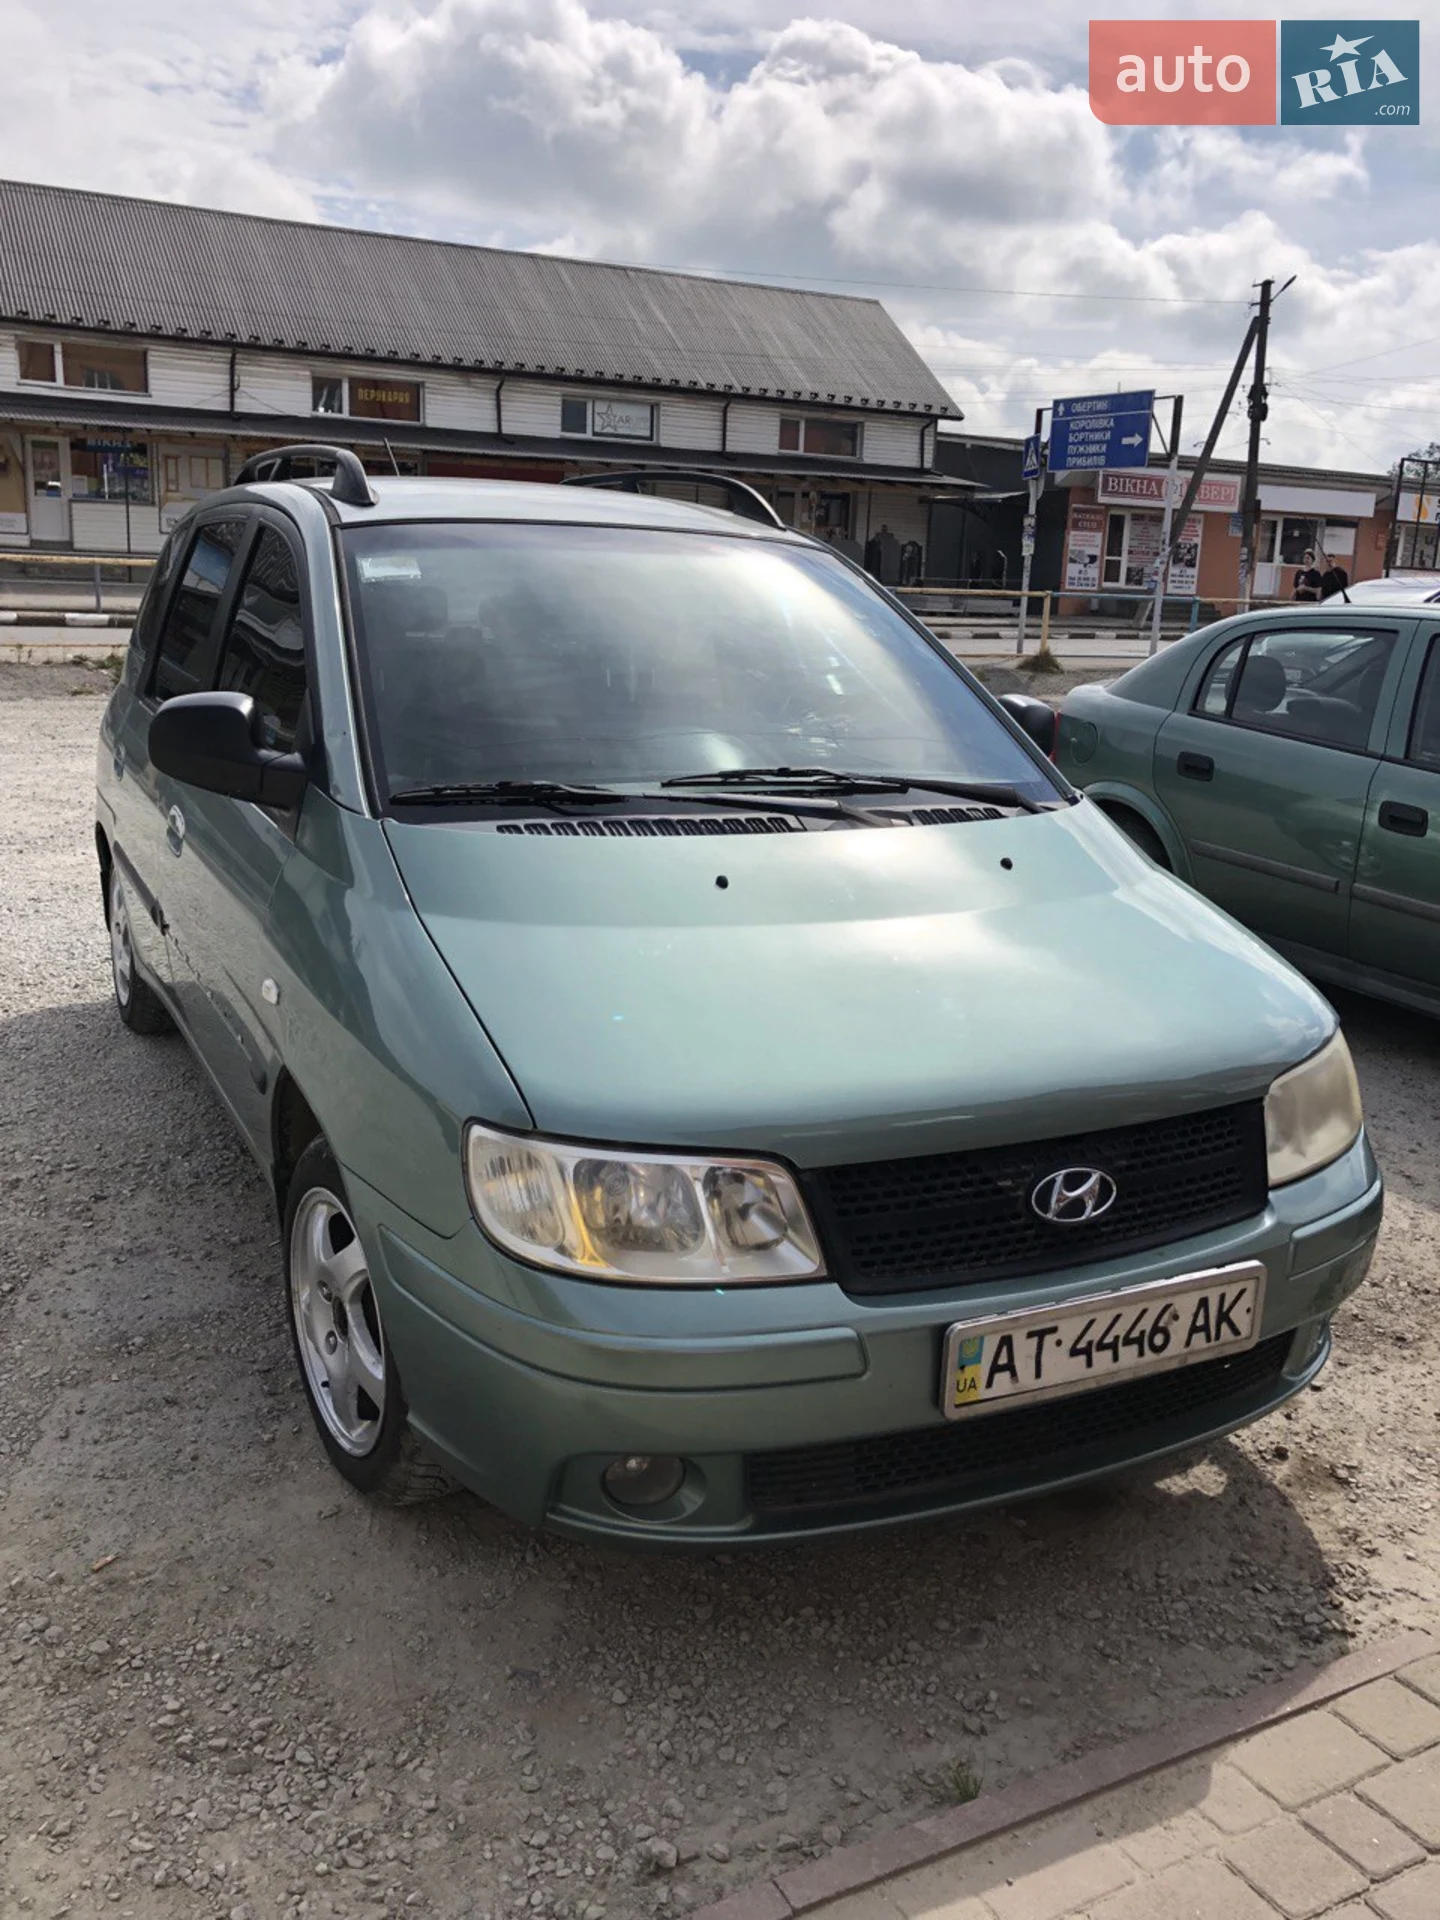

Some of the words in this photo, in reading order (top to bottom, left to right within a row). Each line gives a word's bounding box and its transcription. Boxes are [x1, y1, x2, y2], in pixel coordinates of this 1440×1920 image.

[1071, 401, 1108, 413] ОБЕРТИН
[1069, 418, 1115, 430] КОРОЛІВКА
[1068, 431, 1111, 442] БОРТНИКИ
[1067, 444, 1107, 455] ПУЖНИКИ
[1066, 456, 1106, 468] ПРИБИЛІВ
[1107, 476, 1159, 496] ВІКНА
[1194, 485, 1236, 501] ВЕРІ
[1069, 1303, 1174, 1369] 4446
[956, 1378, 978, 1394] UA
